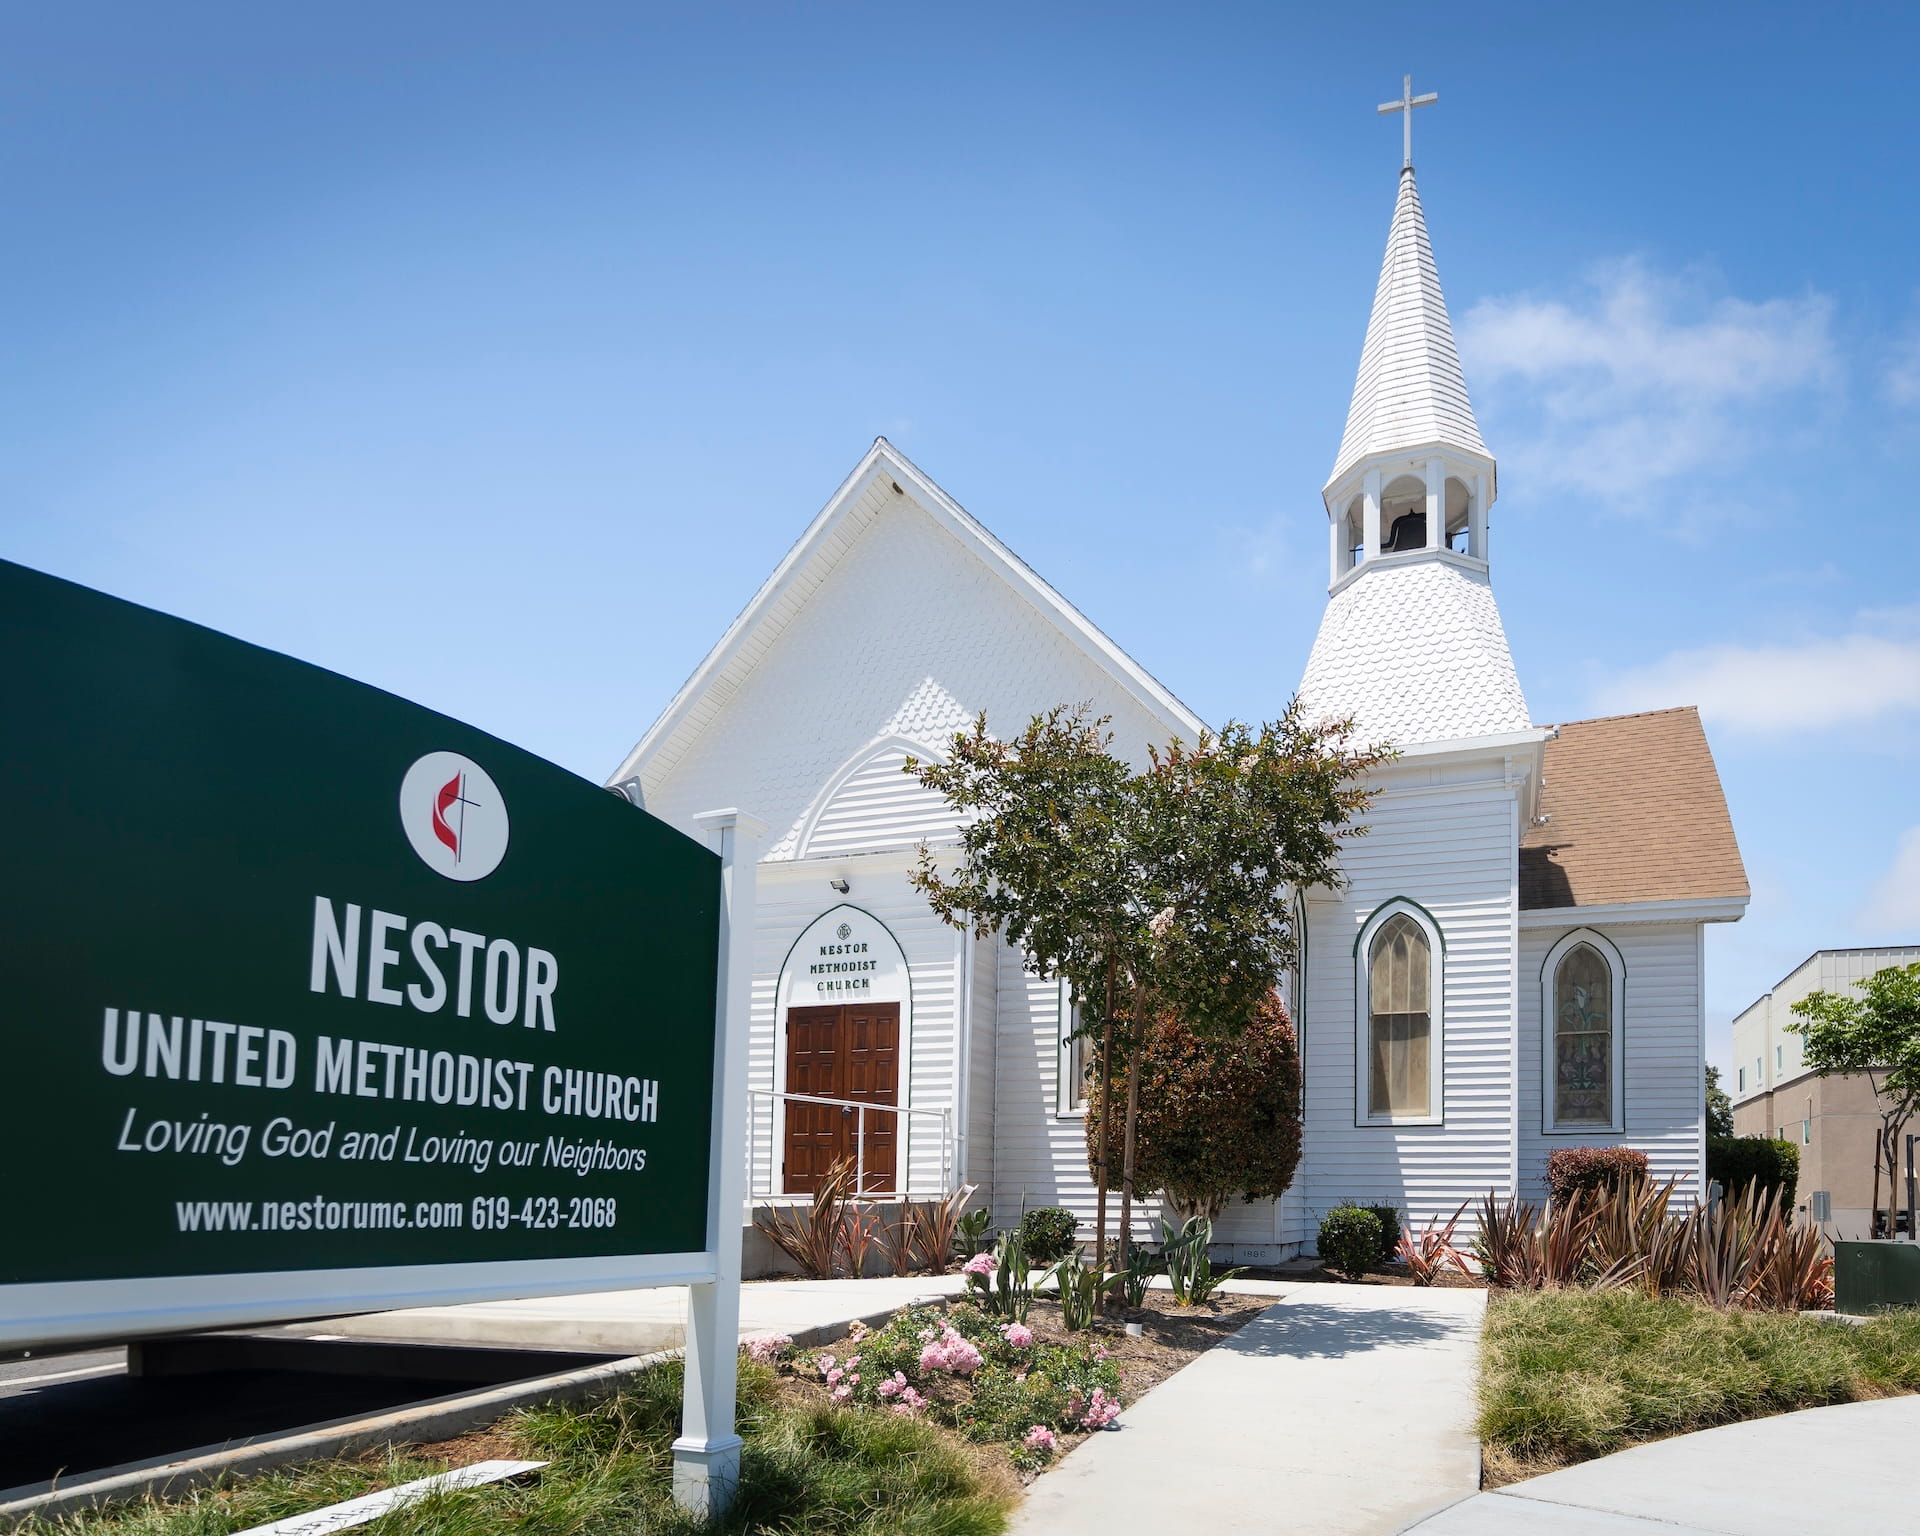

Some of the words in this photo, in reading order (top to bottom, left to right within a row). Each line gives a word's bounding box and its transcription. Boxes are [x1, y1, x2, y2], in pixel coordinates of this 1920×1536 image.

[310, 895, 558, 1033] NESTOR
[810, 960, 877, 975] METHODIST
[820, 943, 868, 956] NESTOR
[817, 978, 870, 992] CHURCH
[102, 1007, 297, 1089] UNITED
[315, 1035, 534, 1111] METHODIST
[542, 1065, 659, 1123] CHURCH
[117, 1107, 252, 1166] Loving
[261, 1116, 336, 1159] God
[339, 1125, 401, 1161] and
[404, 1126, 494, 1174] Loving
[498, 1139, 541, 1167] our
[542, 1135, 647, 1177] Neighbors
[175, 1194, 463, 1232] www.nestorumc.com
[471, 1195, 617, 1231] 619-423-2068
[260, 1500, 389, 1536] unday
